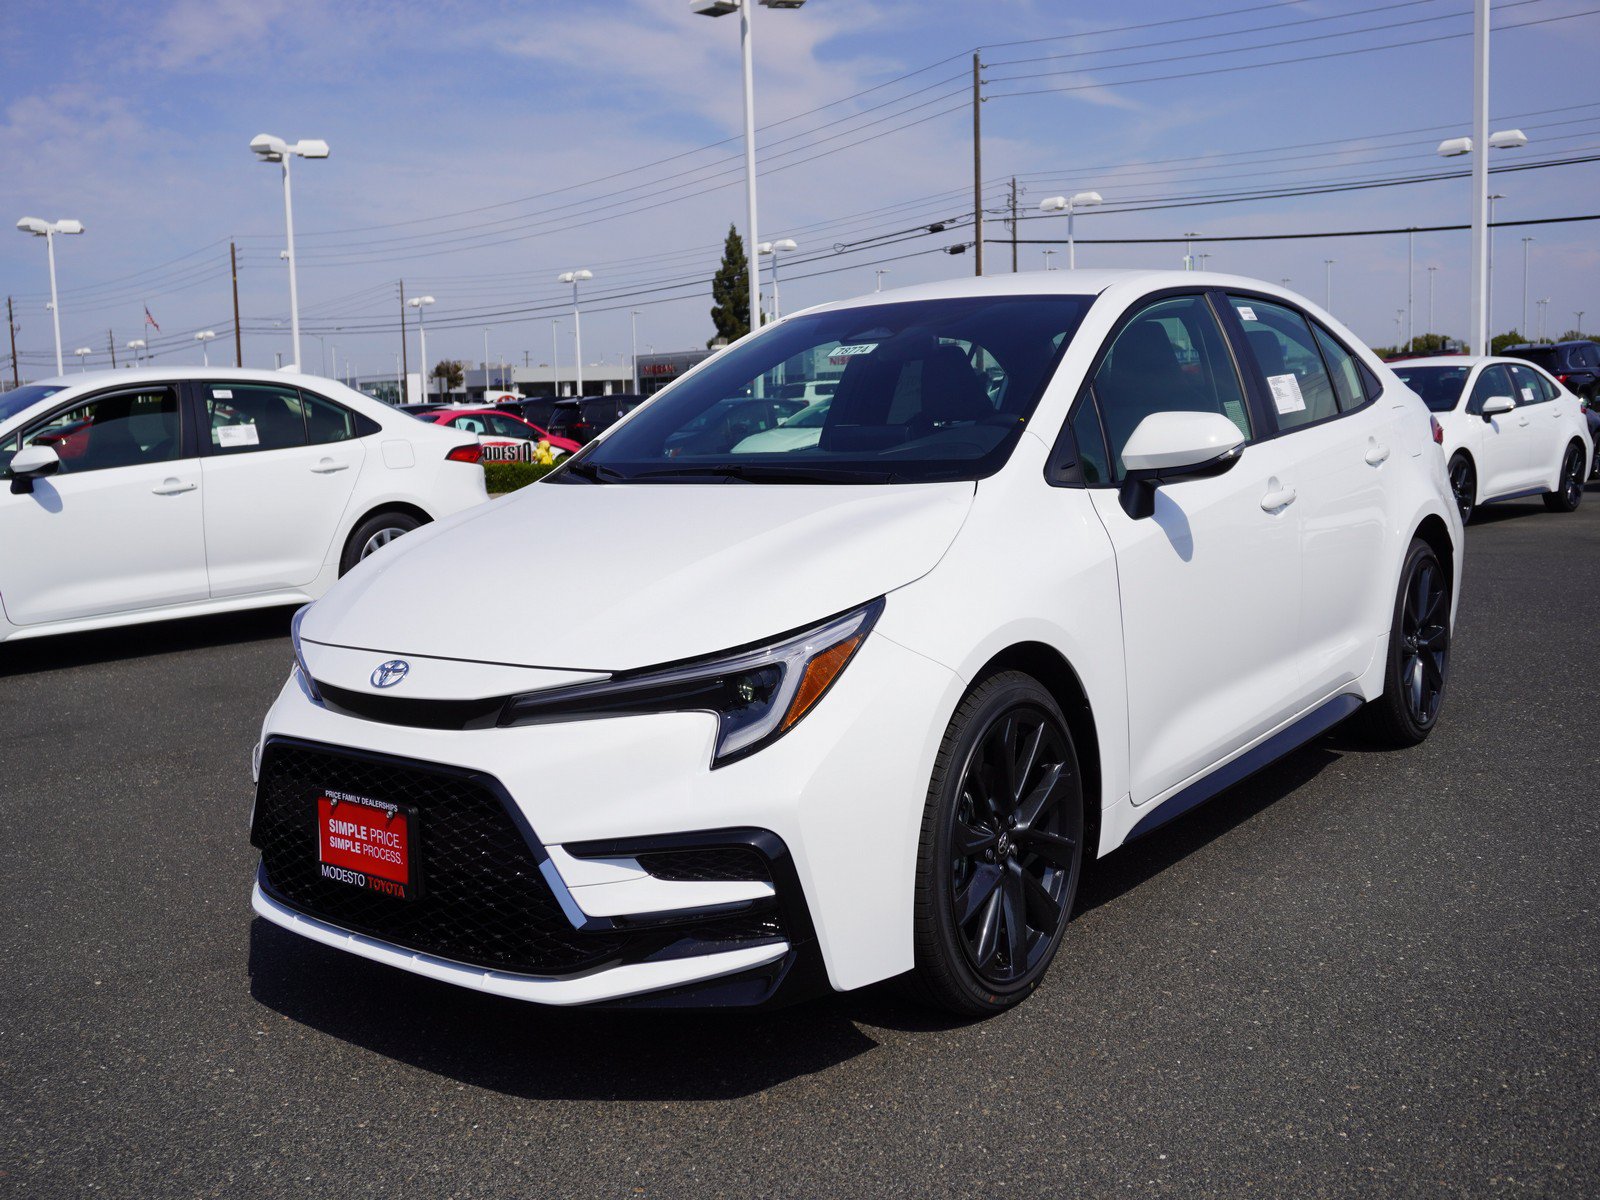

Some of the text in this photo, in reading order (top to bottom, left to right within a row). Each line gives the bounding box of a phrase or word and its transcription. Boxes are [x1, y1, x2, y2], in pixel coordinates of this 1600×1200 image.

[483, 442, 532, 463] ODESTO
[325, 790, 398, 813] PRICE FAMILY DEALERSHIPS
[328, 818, 402, 849] SIMPLE PRICE.
[329, 835, 403, 865] SIMPLE PROCESS.
[321, 864, 405, 898] MODESTO TOYOTA
